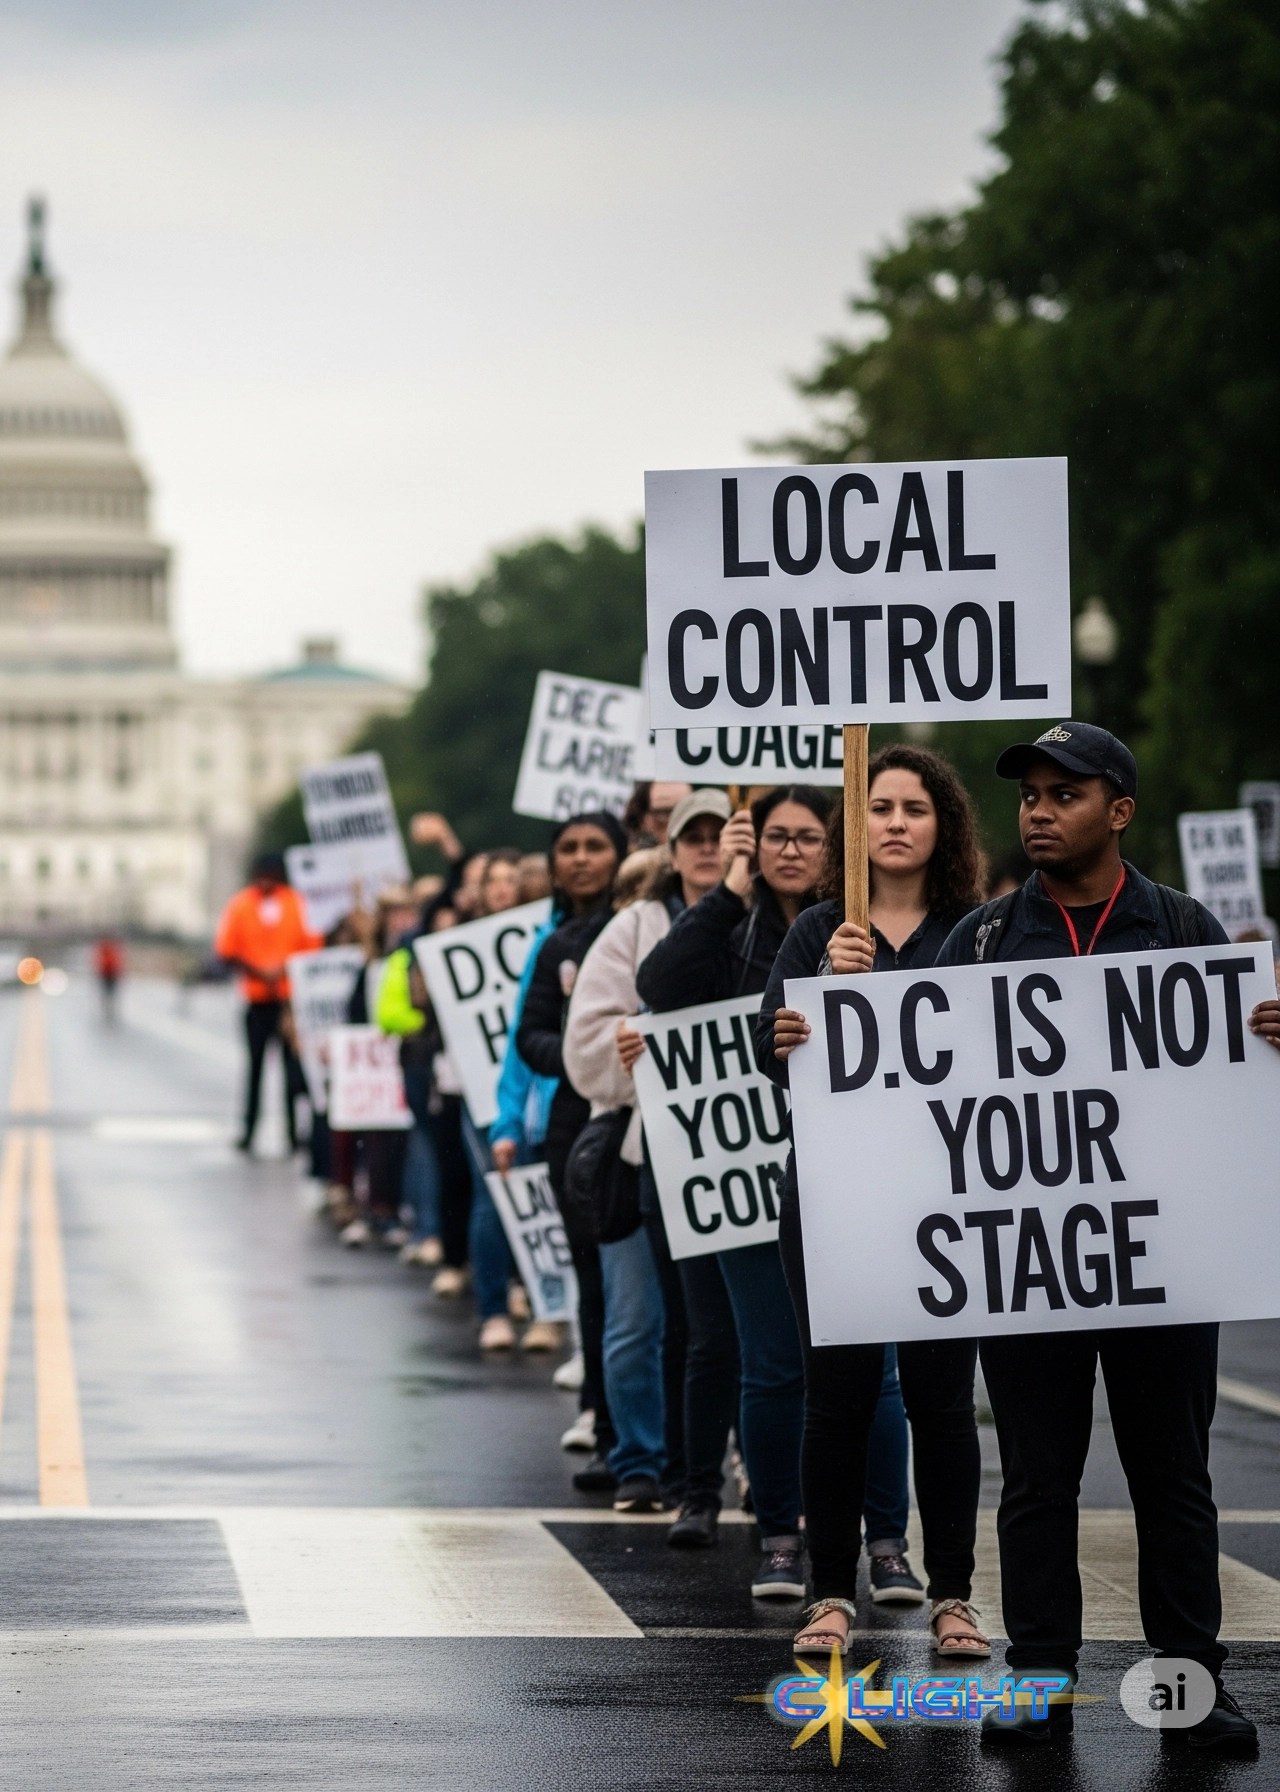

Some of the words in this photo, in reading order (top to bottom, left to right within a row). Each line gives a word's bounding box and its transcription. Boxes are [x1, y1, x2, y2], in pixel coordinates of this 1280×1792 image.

[720, 470, 998, 579] LOCAL
[666, 600, 1050, 711] CONTROL
[443, 922, 543, 1002] D.C
[821, 980, 954, 1095] D.C
[990, 972, 1068, 1081] IS
[1102, 955, 1257, 1073] NOT
[926, 1087, 1127, 1196] YOUR
[915, 1199, 1168, 1319] STAGE
